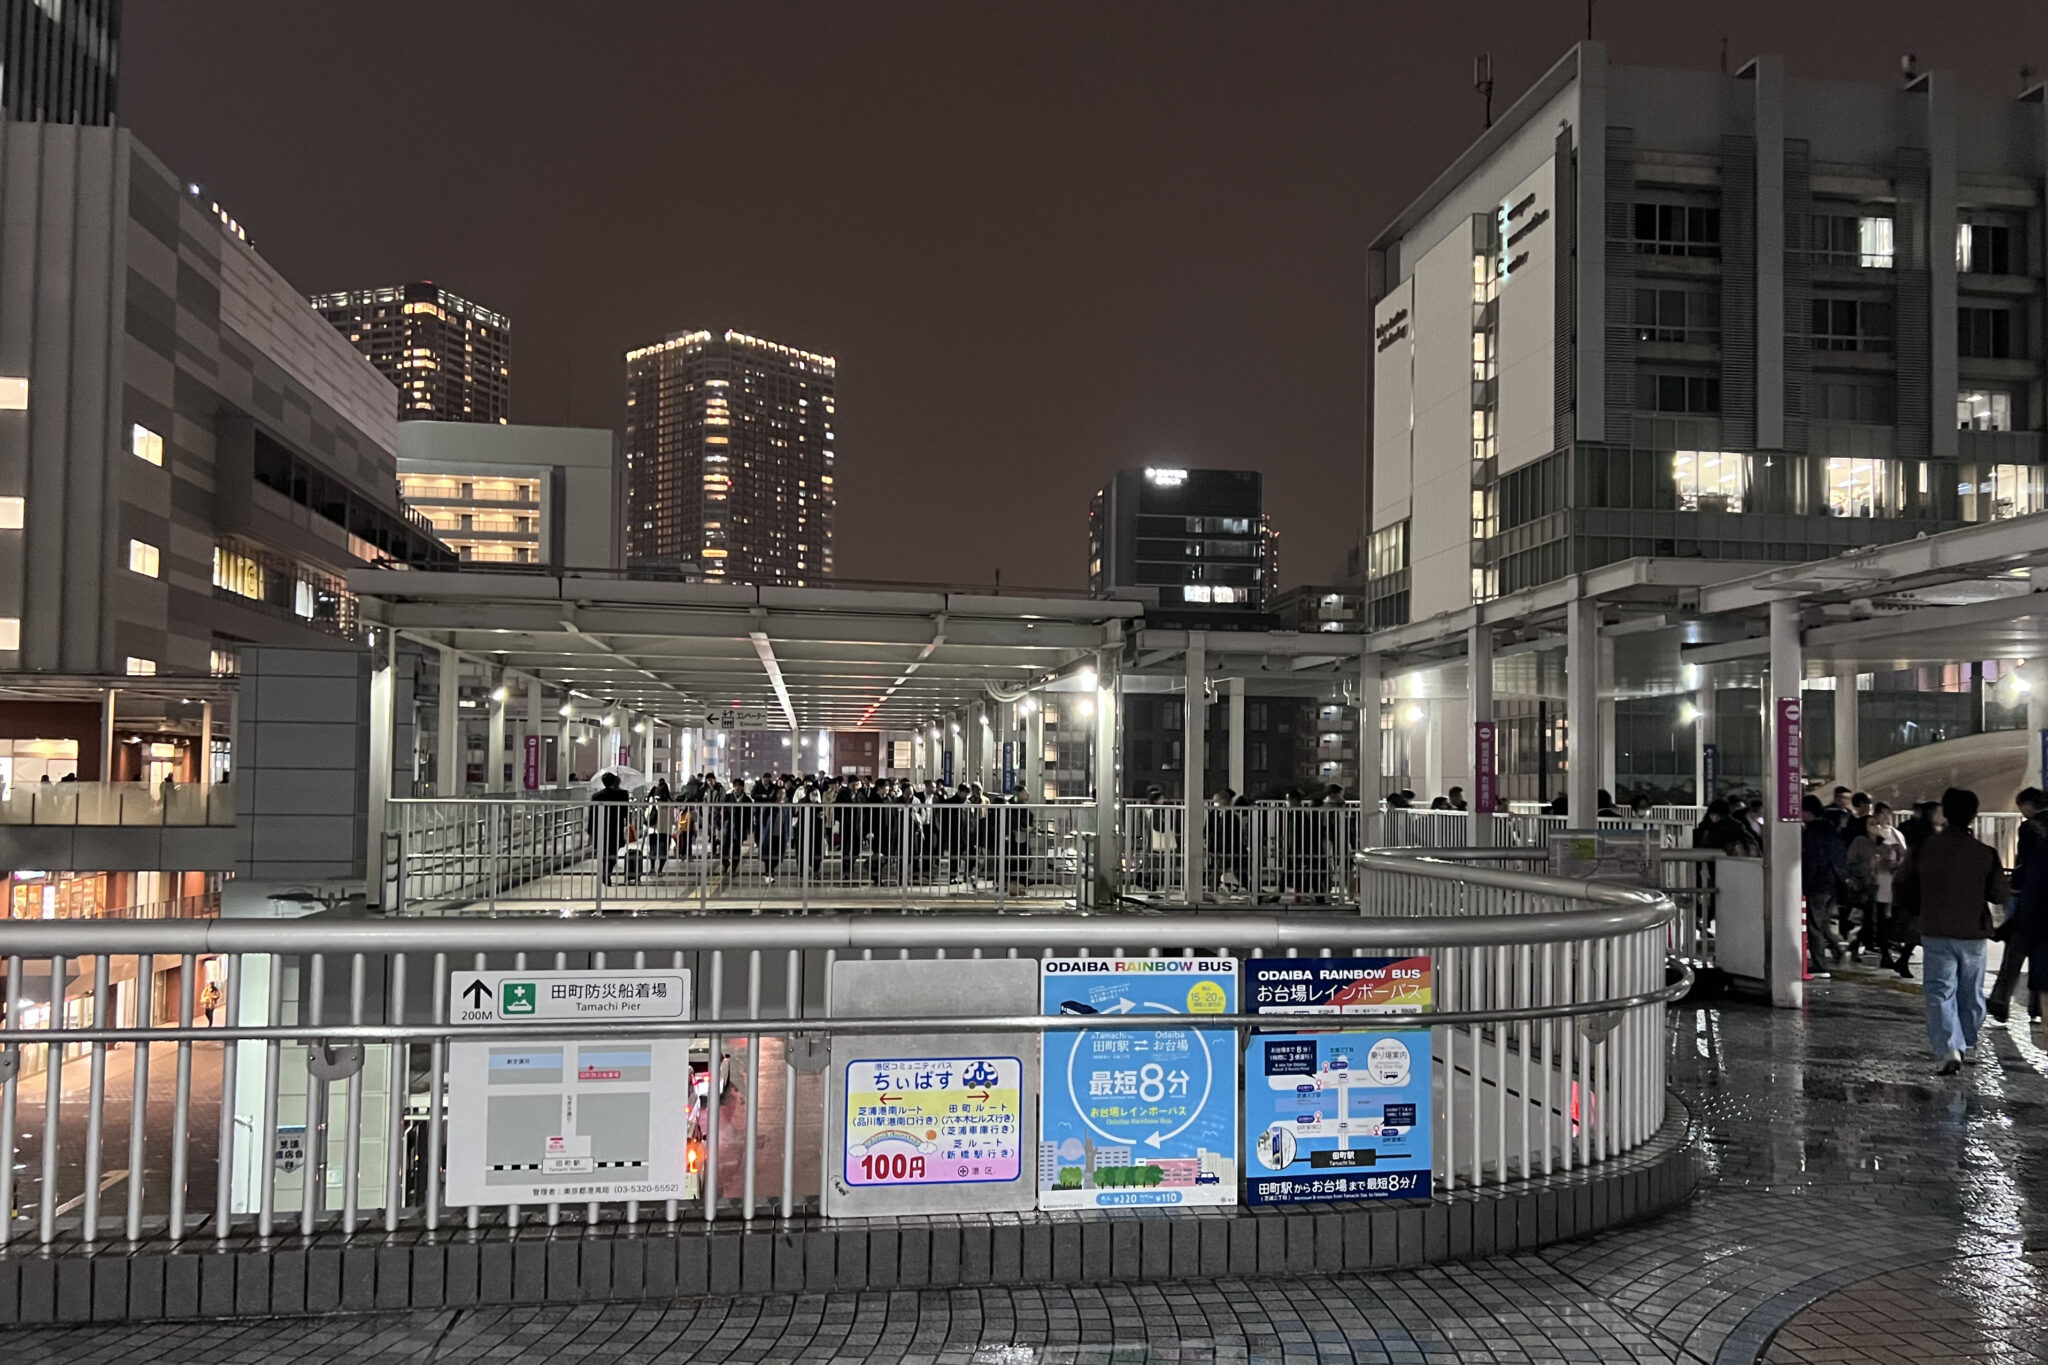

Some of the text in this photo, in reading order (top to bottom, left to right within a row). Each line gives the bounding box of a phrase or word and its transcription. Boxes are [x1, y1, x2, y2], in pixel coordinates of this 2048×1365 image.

[1045, 961, 1233, 972] ODAIBA RAINBOW BUS
[1257, 969, 1421, 981] ODAIBA RAINBOW BUS
[551, 982, 667, 1000] 田町防災船着場
[1257, 983, 1421, 1003] お台場レインボーバス
[576, 1002, 641, 1012] Tamachi Pier
[461, 1010, 493, 1021] 200M
[1095, 1031, 1127, 1039] Tamachi
[1093, 1039, 1188, 1052] 田町駅 お台場
[874, 1062, 953, 1071] 港区コミュニティバス
[873, 1070, 953, 1091] ちぃばす
[1089, 1063, 1190, 1102] 最短8分
[858, 1105, 923, 1116] 芝浦港南ルート
[948, 1103, 1008, 1113] 田町ルート
[1090, 1106, 1187, 1118] お台場レインボーバス
[941, 1113, 1015, 1125] (六本木ヒルズ行き)
[953, 1138, 1003, 1149] 芝ルート
[1332, 1151, 1355, 1160] 田町駅
[861, 1153, 926, 1181] 100円
